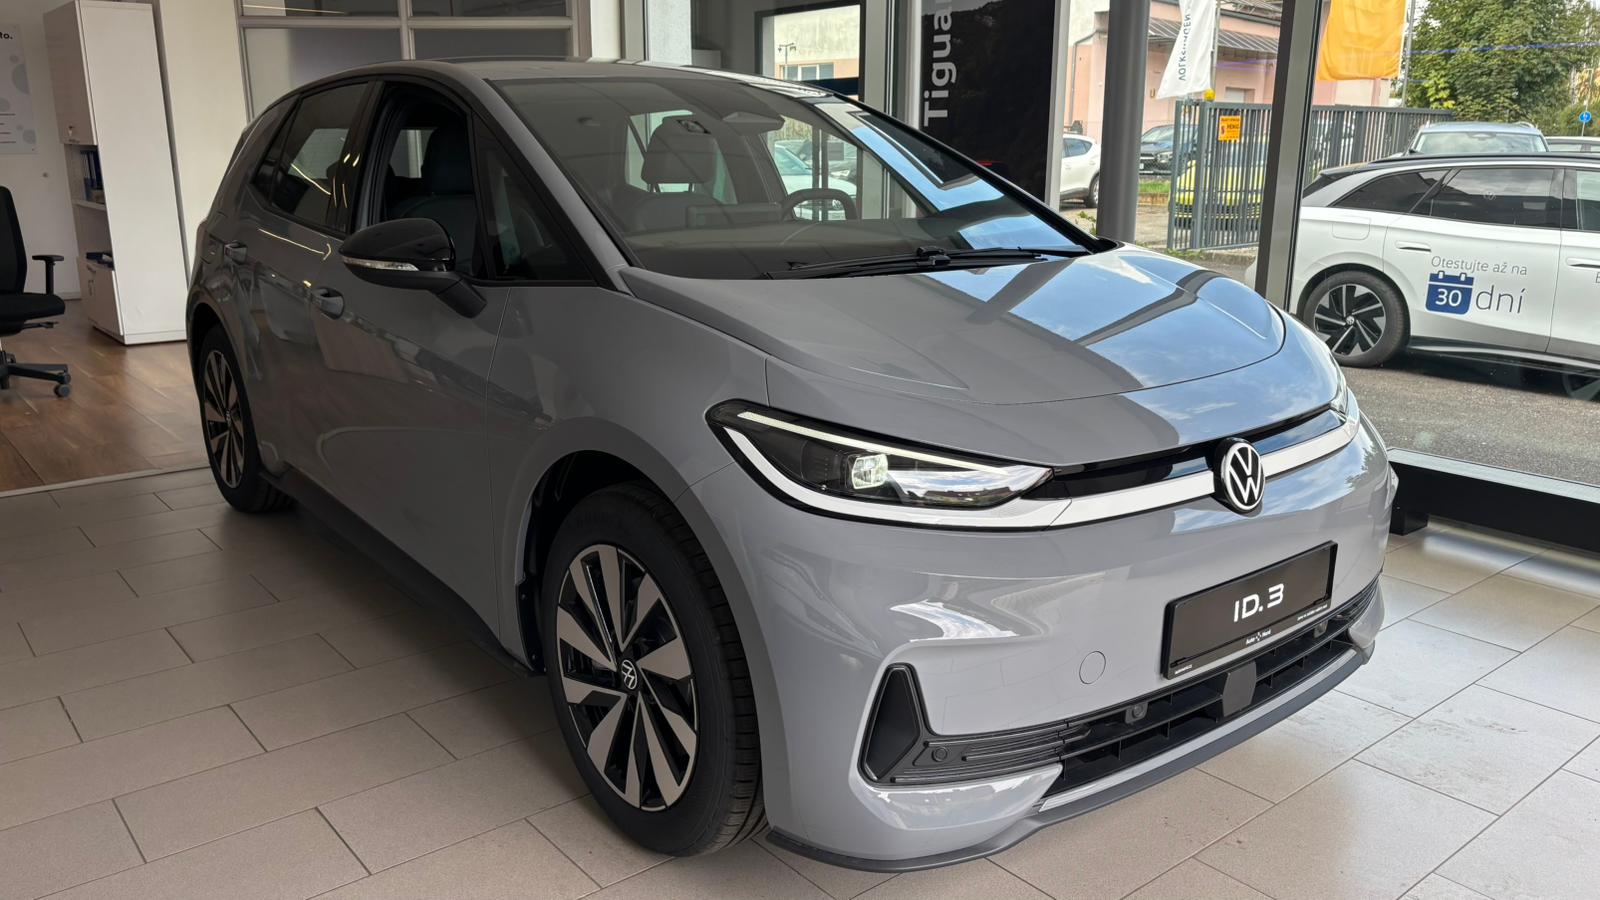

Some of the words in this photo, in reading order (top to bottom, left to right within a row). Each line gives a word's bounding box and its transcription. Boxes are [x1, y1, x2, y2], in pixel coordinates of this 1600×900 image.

[924, 0, 957, 127] Tigua
[1431, 256, 1489, 274] Otestujte
[1493, 261, 1507, 274] až
[1511, 264, 1527, 276] na
[1435, 288, 1462, 307] 30
[1475, 284, 1526, 314] dní
